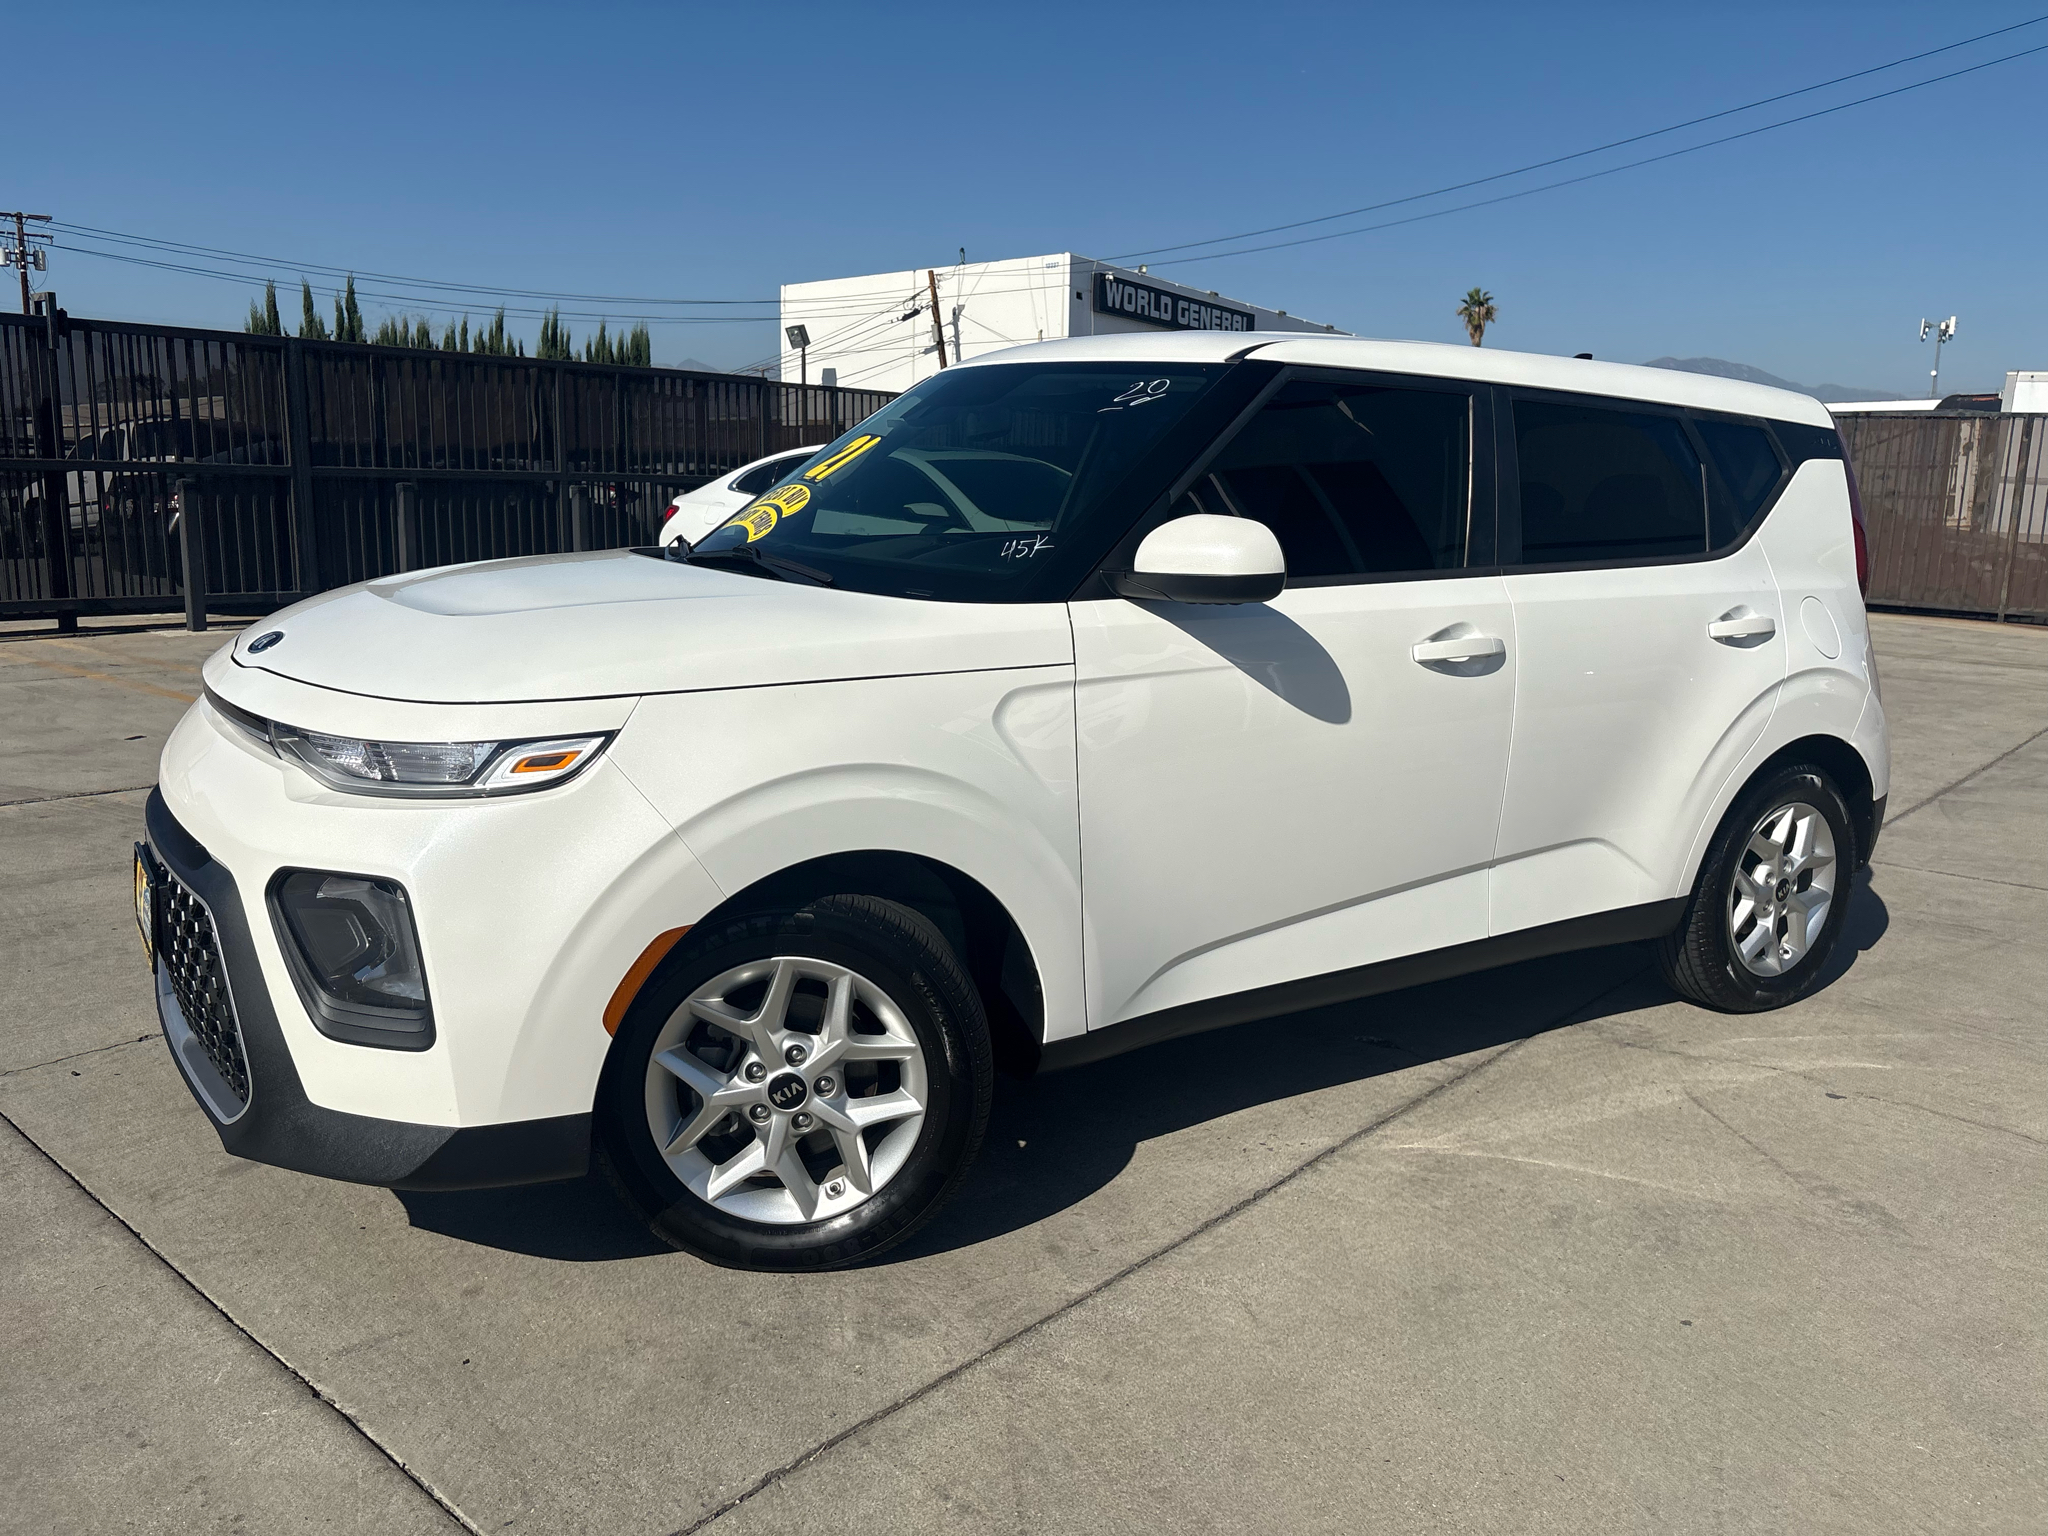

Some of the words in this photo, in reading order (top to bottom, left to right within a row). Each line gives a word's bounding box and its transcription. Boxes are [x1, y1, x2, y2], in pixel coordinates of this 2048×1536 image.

[1105, 280, 1172, 320] WORLD
[803, 435, 882, 482] 21
[783, 488, 808, 509] BUY
[1001, 534, 1055, 563] 45K
[1778, 883, 1789, 898] KIA
[772, 1082, 803, 1104] KIA
